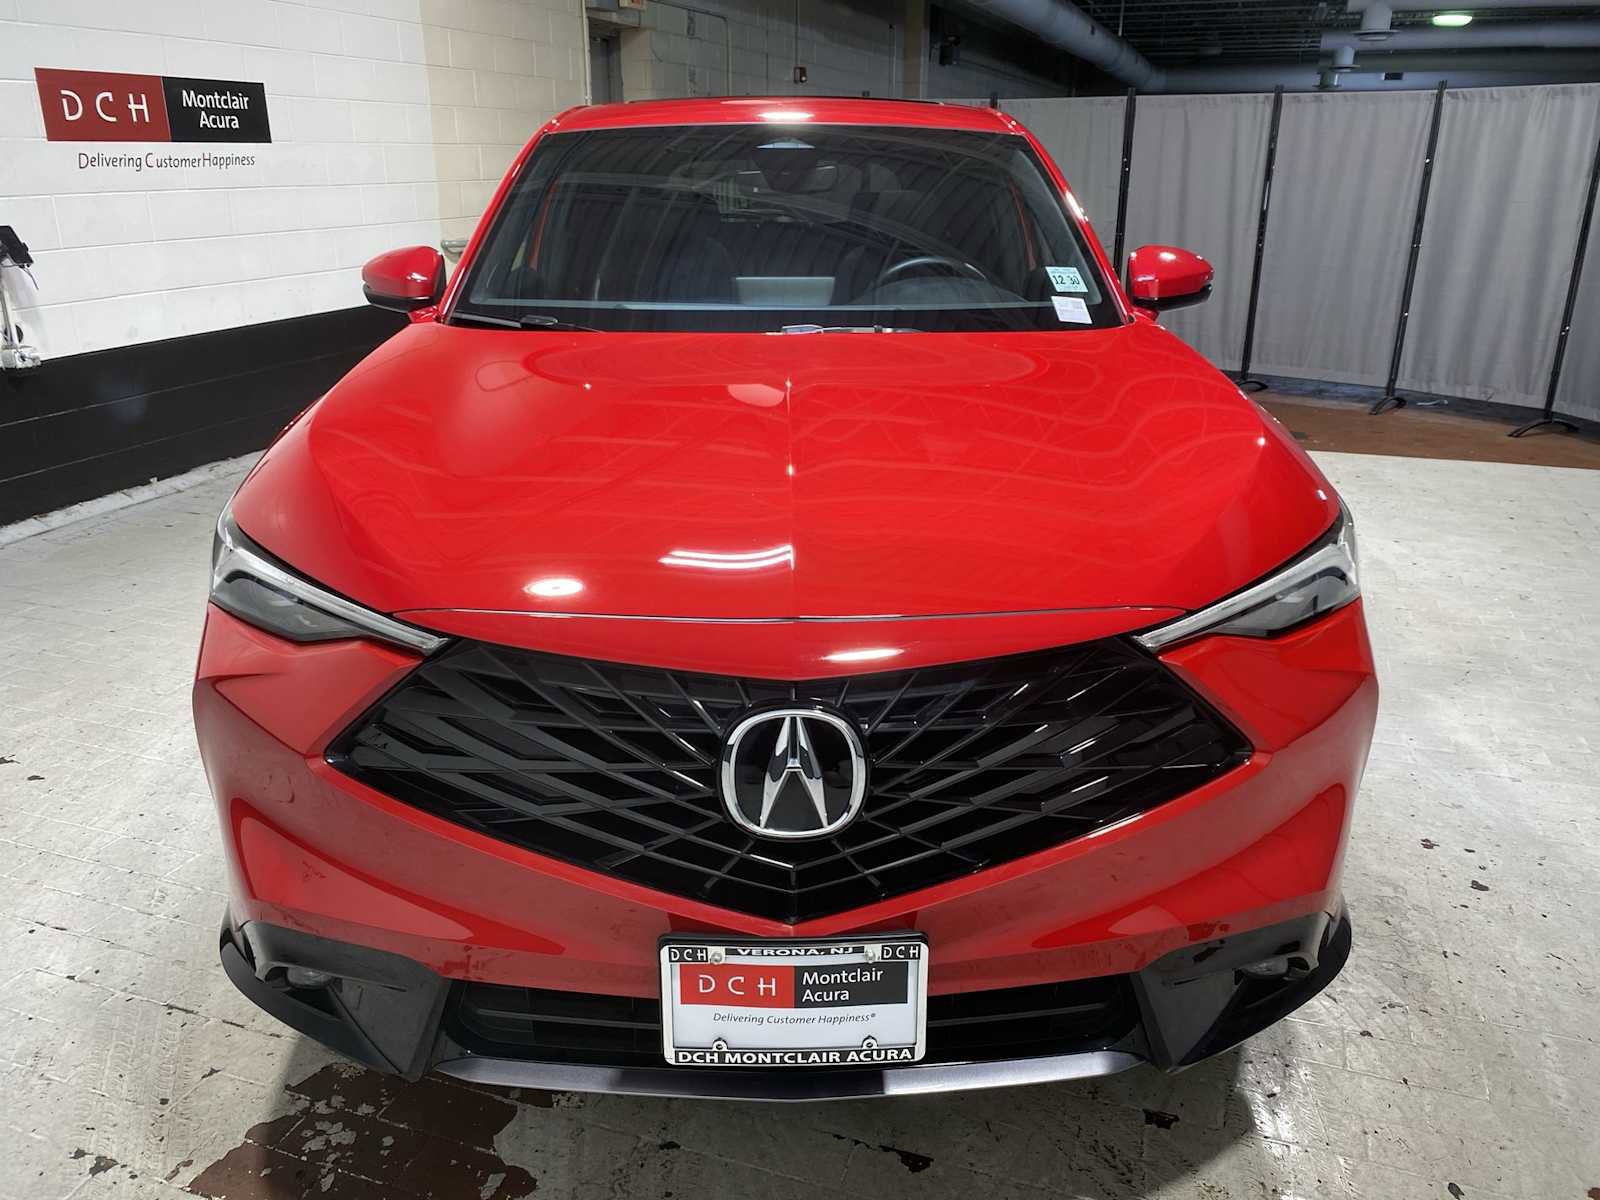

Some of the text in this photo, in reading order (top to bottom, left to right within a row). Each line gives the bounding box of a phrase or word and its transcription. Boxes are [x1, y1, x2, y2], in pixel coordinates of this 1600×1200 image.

[60, 89, 150, 122] DCH
[182, 89, 249, 110] Montclair
[199, 111, 240, 129] Acura
[78, 152, 256, 171] Delivering Customer Happiness
[1052, 275, 1066, 285] 12
[670, 949, 707, 962] DCH
[737, 947, 853, 956] VERONA, NJ
[882, 946, 920, 959] DCH
[802, 967, 884, 986] Montclair
[698, 974, 776, 996] DCH
[802, 988, 850, 1002] Acura
[713, 1012, 764, 1025] Delivering
[766, 1014, 816, 1025] Customer
[678, 1048, 912, 1064] DCH MONTCLAIR ACURA
